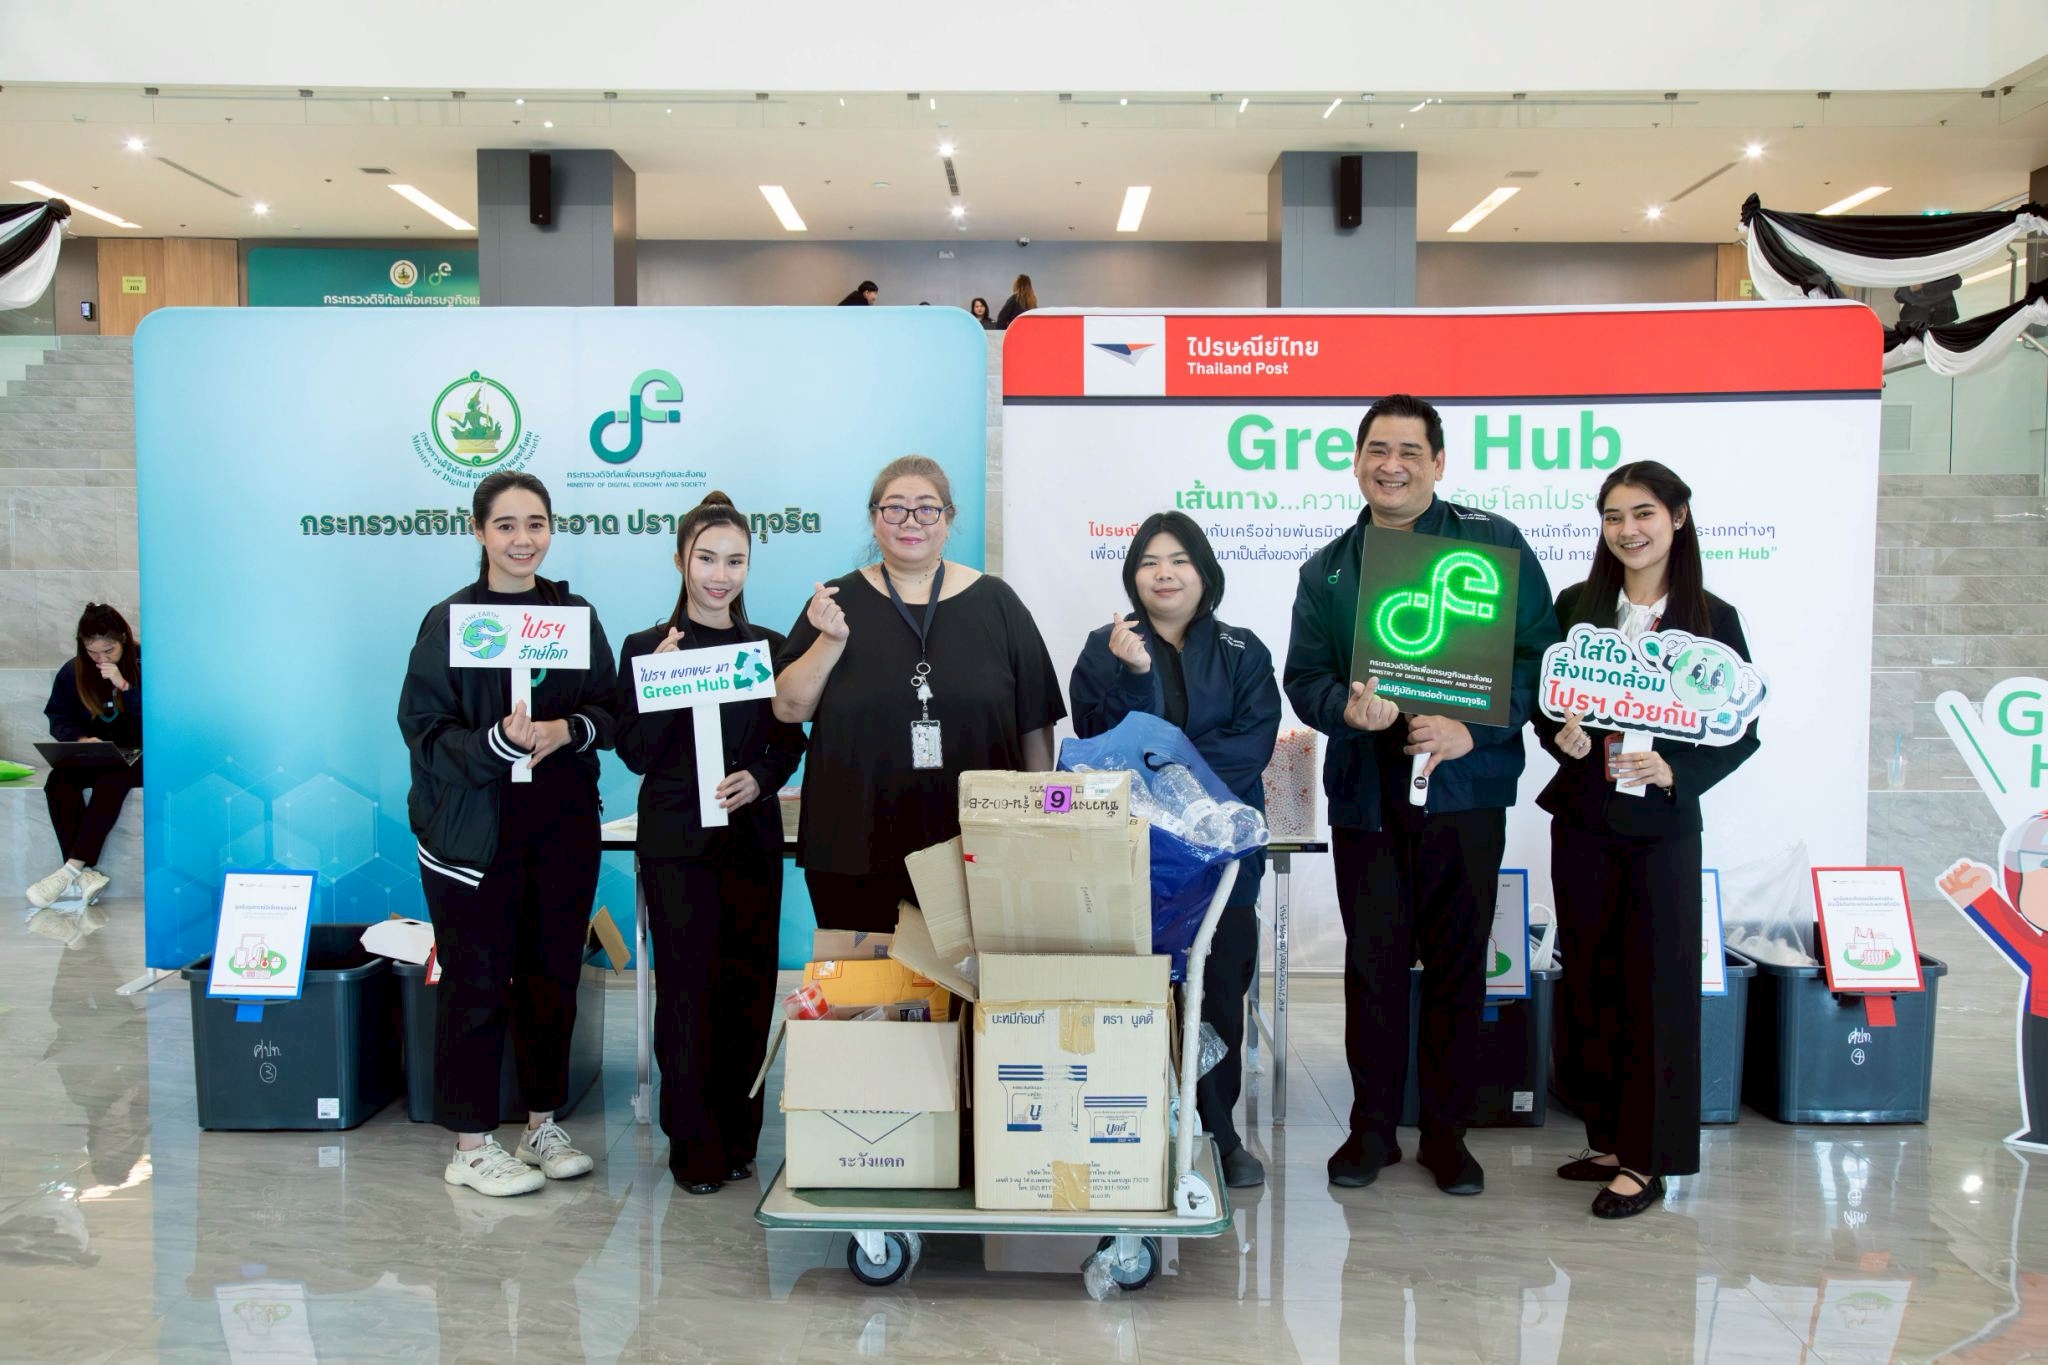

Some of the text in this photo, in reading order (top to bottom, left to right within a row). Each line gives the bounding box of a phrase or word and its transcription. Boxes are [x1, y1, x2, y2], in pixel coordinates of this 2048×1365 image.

[1186, 334, 1319, 357] ไปรษณีย์ไทย
[1186, 361, 1289, 375] Thailand Post
[1474, 410, 1622, 471] Hub
[411, 433, 432, 469] Ministry
[442, 472, 470, 489] Digital
[1088, 521, 1139, 538] ไปรษณี
[1695, 521, 1776, 539] ระเภทต่างๆ
[1579, 634, 1628, 665] ใส่ใจ
[1368, 668, 1394, 677] MINISTRY
[1404, 673, 1426, 682] DIGITAL
[1426, 676, 1454, 685] ECONOMY
[1468, 683, 1492, 692] SOCIETY
[1552, 653, 1666, 693] สิ่งแวดล้อม
[642, 676, 730, 699] Green Hub
[1375, 683, 1487, 707] ูนย์ปฏิบัติการต่อต้านการทุจริต
[1549, 679, 1697, 729] ไปรฯ ด้วยกัน
[1102, 1015, 1123, 1025] ตรา
[838, 1151, 905, 1169] ระวังแตก
